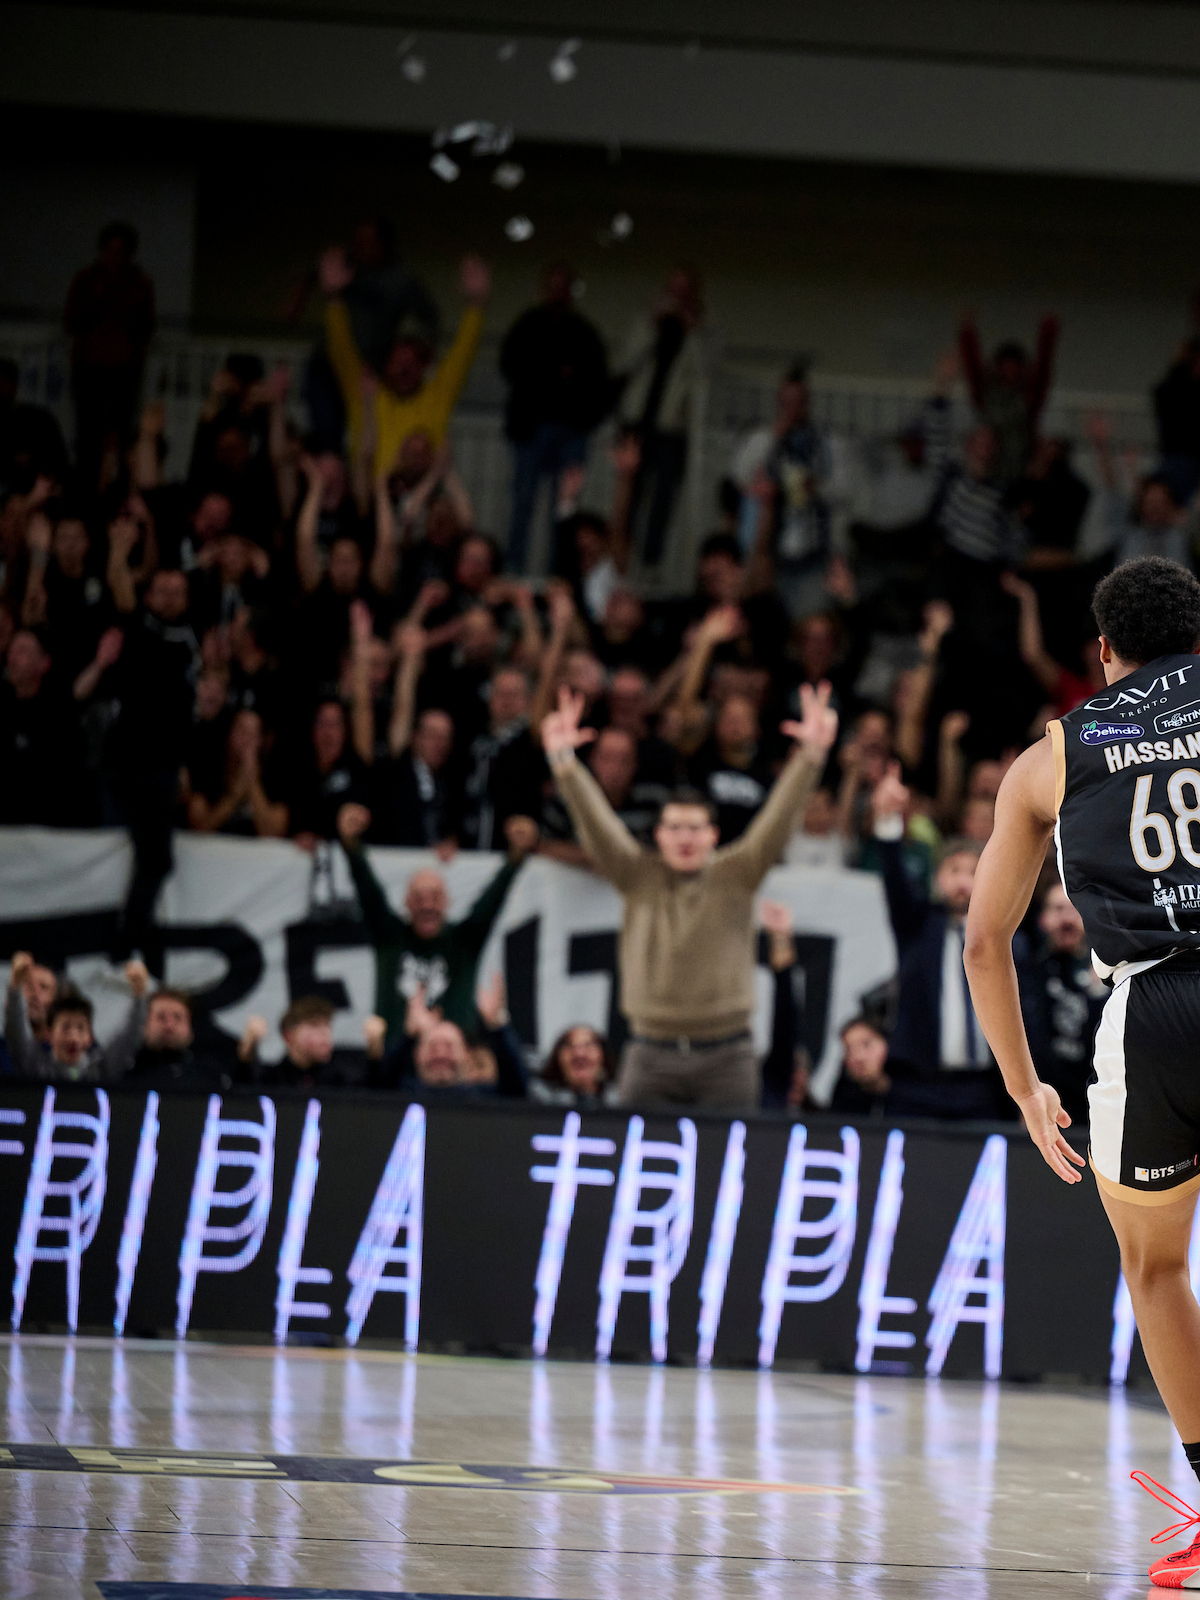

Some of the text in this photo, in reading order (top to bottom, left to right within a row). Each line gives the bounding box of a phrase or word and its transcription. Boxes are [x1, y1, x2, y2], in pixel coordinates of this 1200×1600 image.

[1083, 664, 1193, 711] CAVIT
[1119, 697, 1168, 718] TRENTO
[1150, 1165, 1175, 1180] BTS
[529, 1111, 1008, 1380] TRIPLA
